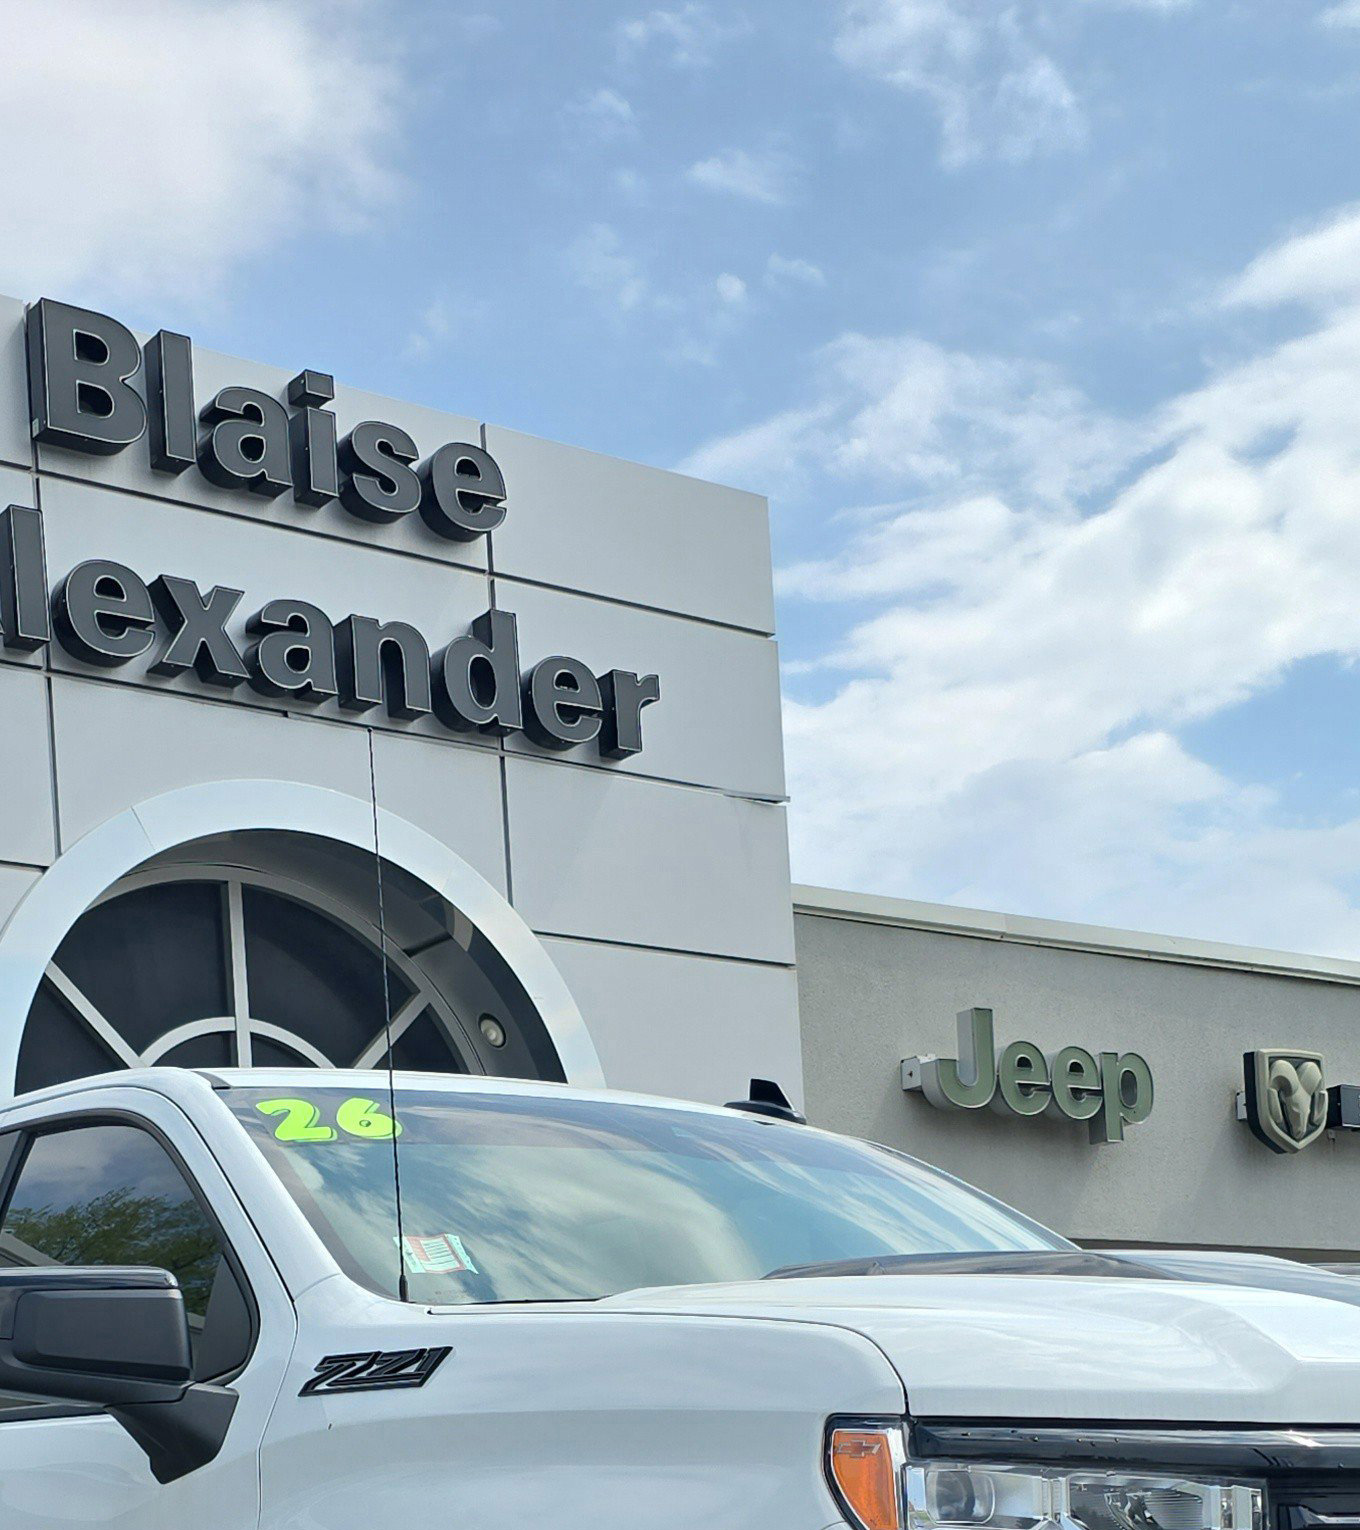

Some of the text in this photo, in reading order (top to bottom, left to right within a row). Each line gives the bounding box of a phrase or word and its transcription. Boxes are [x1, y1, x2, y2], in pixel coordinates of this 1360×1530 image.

[27, 297, 507, 543] Blaise
[255, 1097, 404, 1142] 26
[920, 1007, 1154, 1144] Jeep
[297, 1345, 454, 1397] Z71
